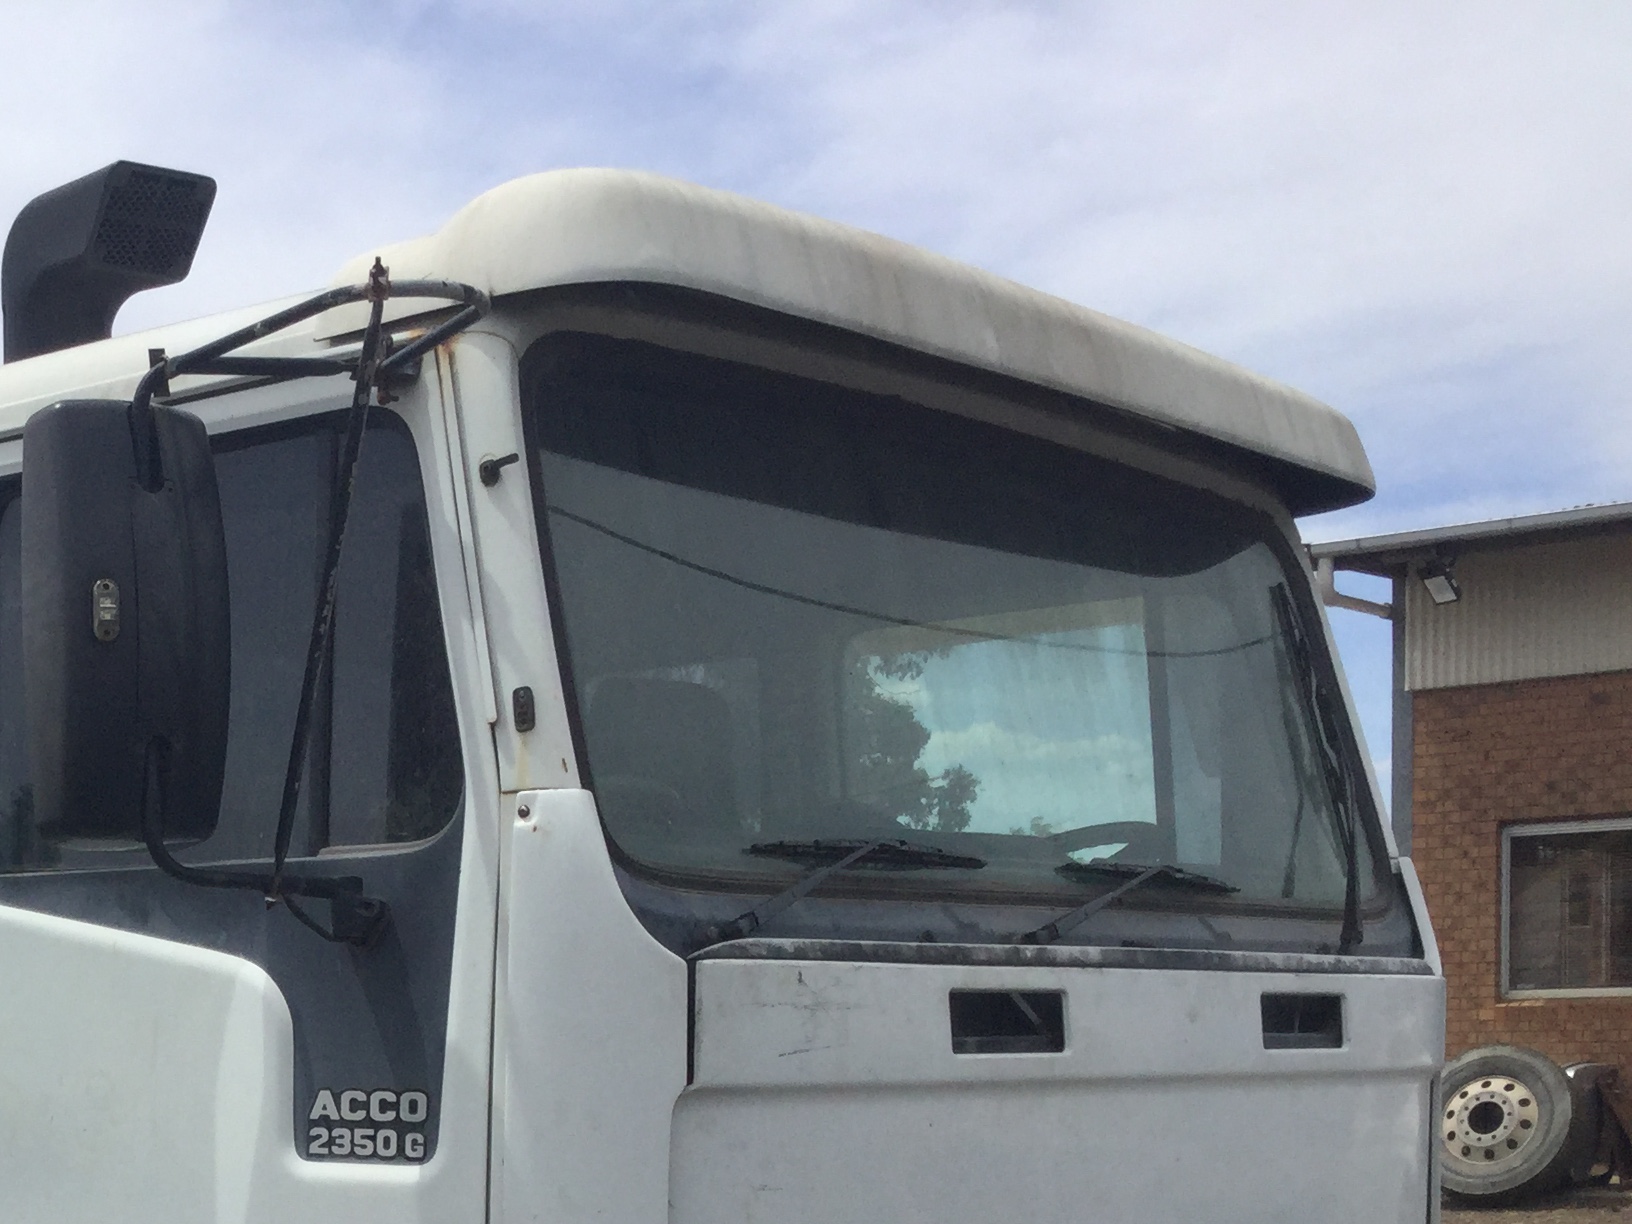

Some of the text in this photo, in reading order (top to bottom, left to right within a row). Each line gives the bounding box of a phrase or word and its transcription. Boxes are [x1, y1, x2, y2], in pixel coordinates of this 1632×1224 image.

[309, 1088, 428, 1123] ACCO
[308, 1126, 425, 1158] 2350 G
